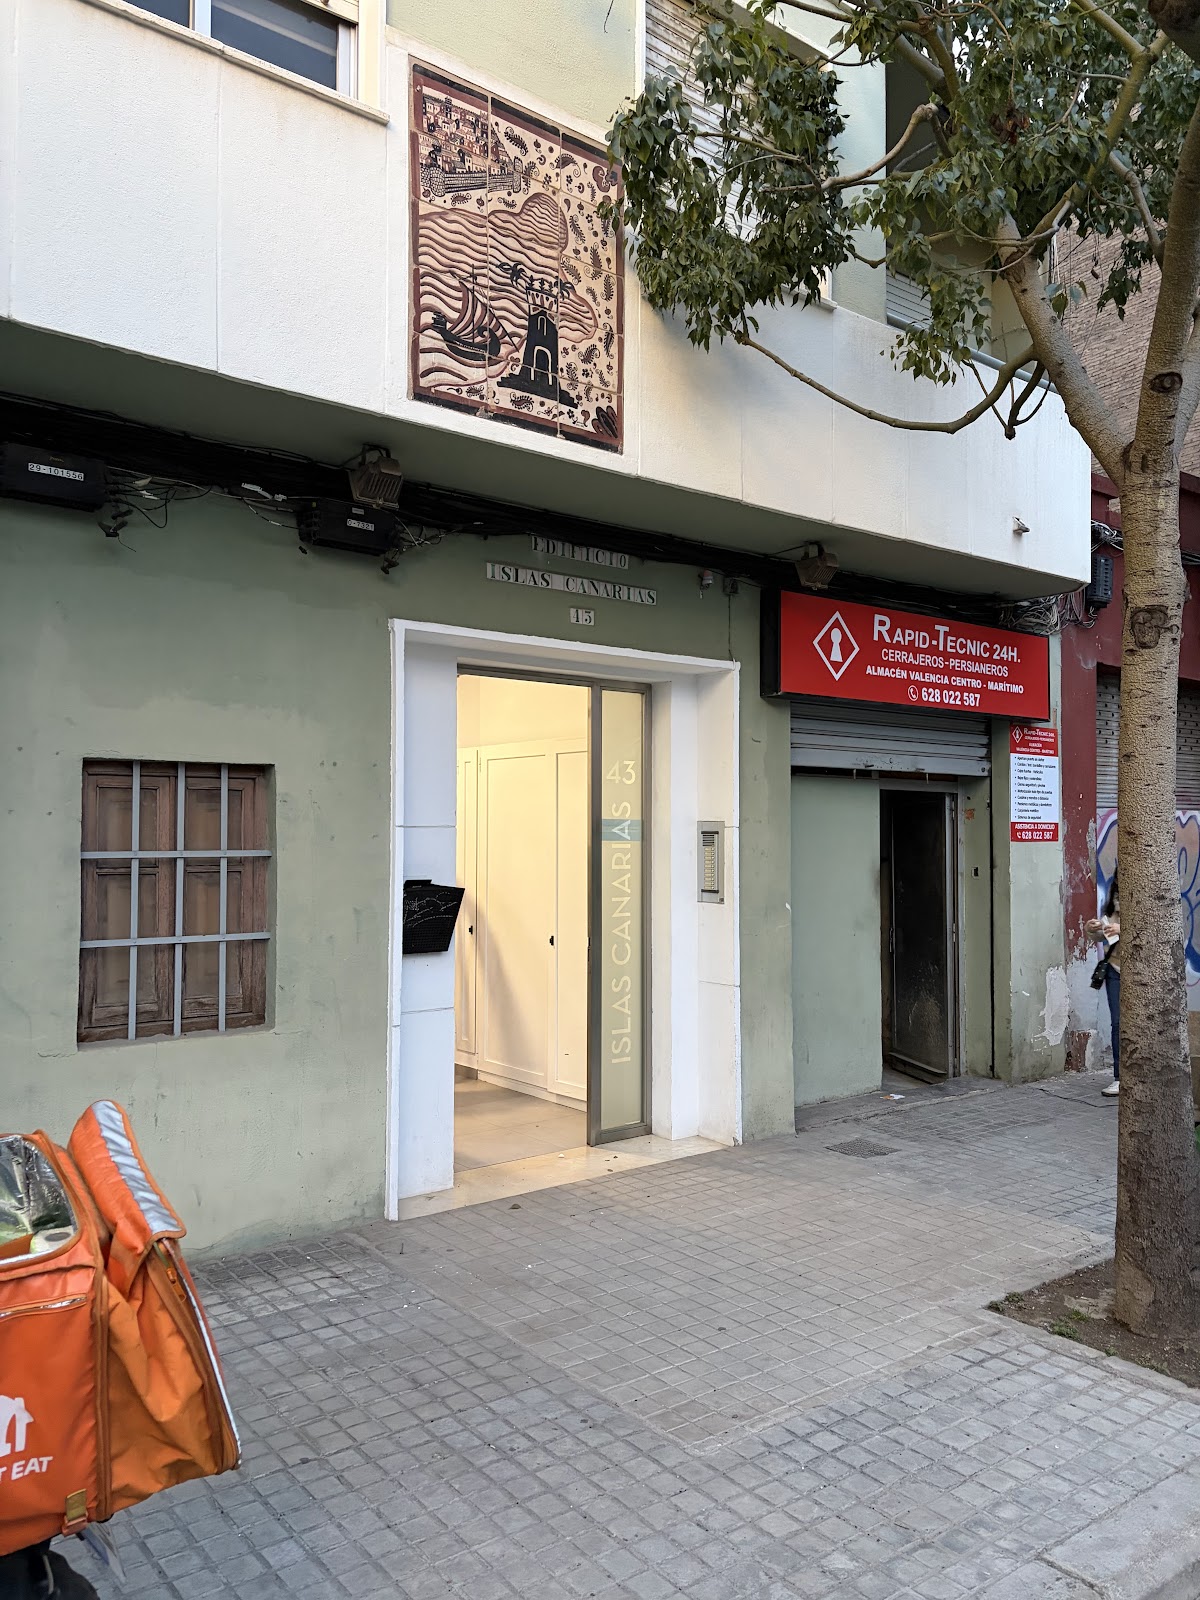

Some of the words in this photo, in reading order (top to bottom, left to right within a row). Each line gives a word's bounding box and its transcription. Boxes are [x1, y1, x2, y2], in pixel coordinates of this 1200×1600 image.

[532, 534, 627, 568] EDIFICIO
[489, 563, 551, 588] ISLAS
[565, 577, 656, 605] CANARIAS
[992, 643, 1021, 663] 24H.
[866, 664, 908, 680] ALMACÉN
[909, 670, 950, 685] VALENCIA
[951, 676, 982, 689] CENTRO
[987, 681, 1025, 694] MARÍTIMO
[921, 687, 941, 703] 628
[942, 689, 962, 705] 022
[963, 691, 981, 707] 587
[605, 759, 637, 785] 43
[1022, 831, 1032, 840] 628
[1033, 831, 1043, 840] 022
[611, 800, 632, 966] CANARIAS
[611, 975, 632, 1065] ISLAS
[11, 1456, 54, 1481] EAT
